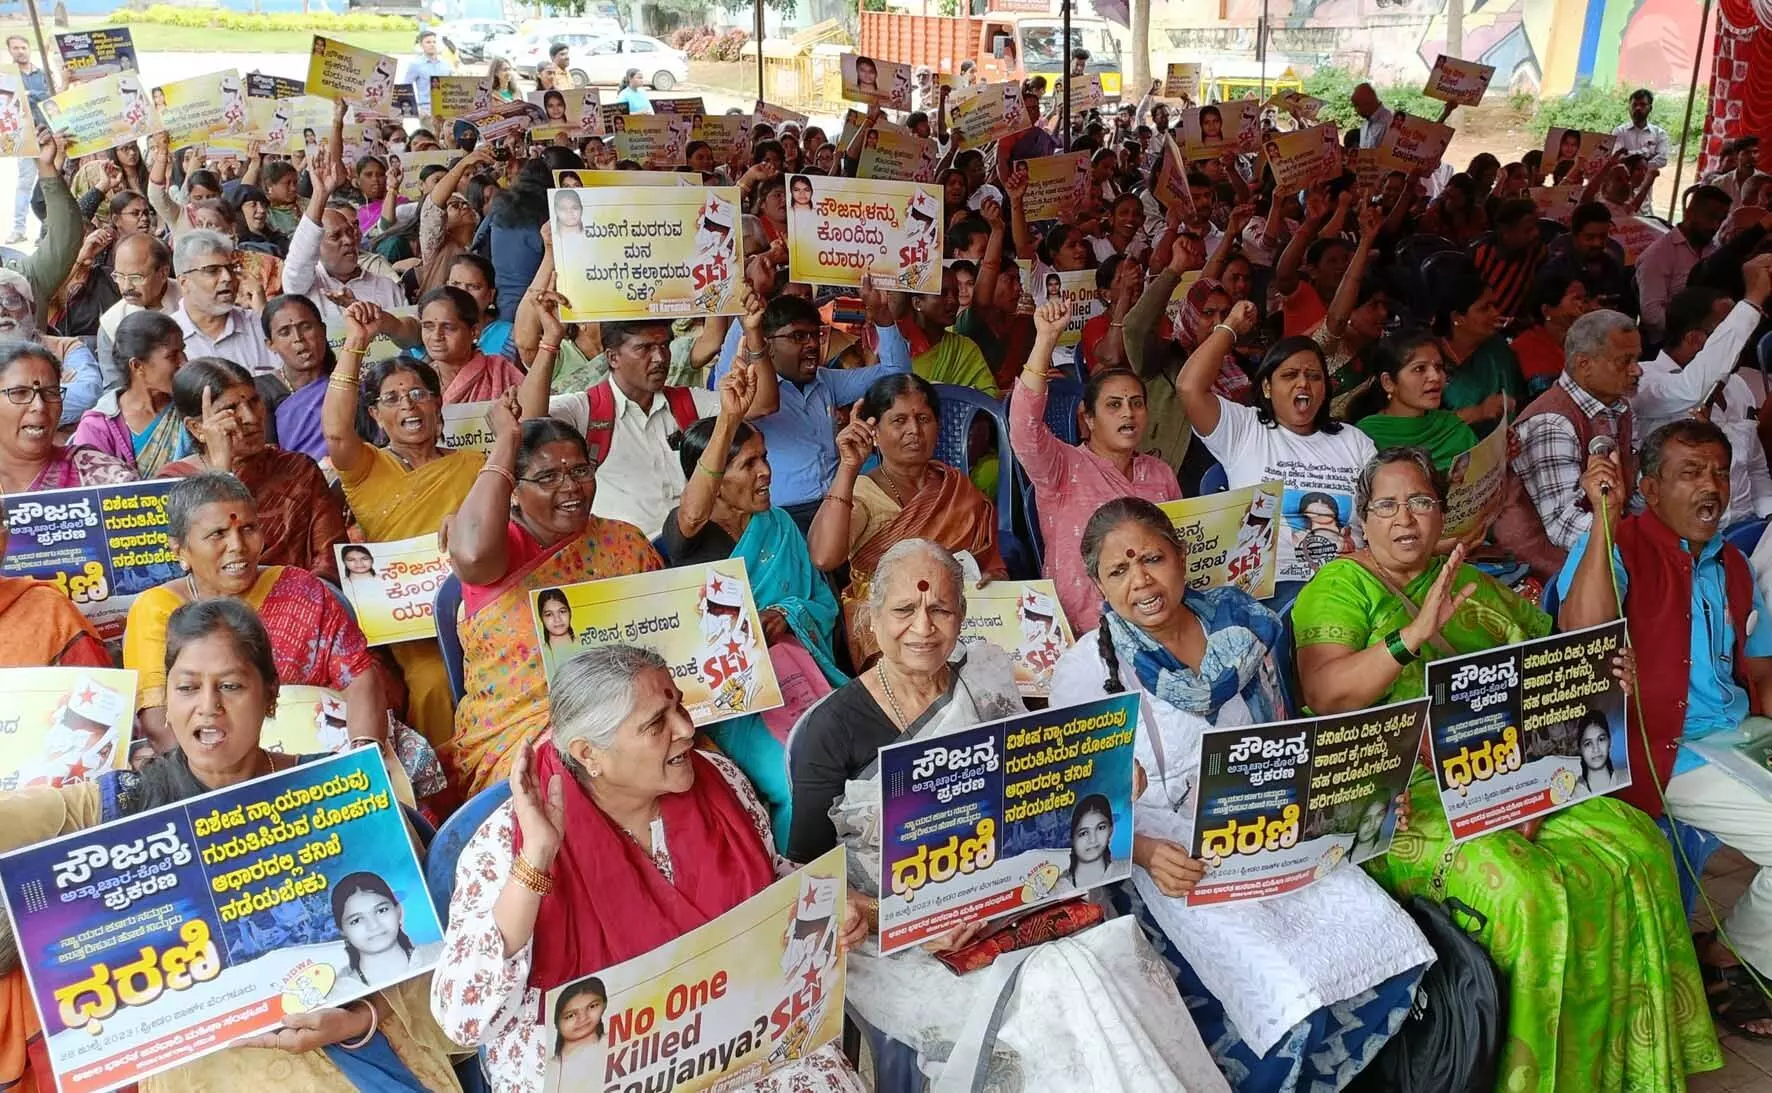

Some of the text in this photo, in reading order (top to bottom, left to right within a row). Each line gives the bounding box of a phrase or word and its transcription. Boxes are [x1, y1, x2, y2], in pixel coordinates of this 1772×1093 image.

[585, 219, 682, 239] ಮುನಿಗೆ ಮರಗುವ
[816, 197, 900, 230] ಸೌಜನ್ಯಳನ್ನು
[624, 242, 652, 260] ಮನ
[817, 223, 887, 254] ಕೊಂದಿದ್ದು
[632, 262, 691, 287] ಕಲ್ಲಾದುದು
[818, 249, 875, 270] ಯಾರು?
[626, 281, 656, 302] ಏಕೆ?
[1062, 289, 1076, 301] No
[1072, 302, 1091, 316] lled
[446, 429, 483, 448] ಮುನಿಗೆ
[8, 498, 98, 527] ಸೌಜನ್ಯ
[103, 495, 139, 511] ವಿಶೇಷ
[11, 519, 84, 536] ಅತ್ಯಾಚಾರ-ಕೊಲೆ
[37, 529, 87, 546] ಪ್ರಕರಣ
[1189, 550, 1228, 573] ತನಿಖೆ
[580, 612, 681, 645] ಸೌಜನ್ಯ ಪ್ರಕರಣದ
[1523, 636, 1617, 669] ತನಿಖೆಯ ದಿಕ್ಕು ತಪ್ಪಿಸಿದ
[1451, 655, 1519, 692] ಸೌಜನ್ಯ
[1523, 664, 1596, 690] ಕಾಣದ ಕೈಗಳನ್ನು
[1470, 692, 1508, 713] ಪ್ರಕರಣ
[1523, 678, 1610, 710] ಸಹ ಆರೋಪಿಗಳೆಂದು
[1006, 707, 1128, 750] ವಿಶೇಷ ನ್ಯಾಯಾಲಯವು
[1316, 712, 1417, 748] ತನಿಖೆಯ ದಿಕ್ಕು ತಪ್ಪಿಸಿದ
[912, 735, 1000, 780] ಸೌಜನ್ಯ
[1005, 728, 1134, 774] ಗುರುತಿಸಿರುವ ಲೋಪಗಳ
[1228, 731, 1310, 765] ಸೌಜನ್ಯ
[1314, 740, 1389, 769] ಕಾಣದ ಕೈಗಳನ್ನು
[1442, 725, 1521, 797] ಧರಣಿ
[912, 765, 985, 793] ಅತ್ಯಾಚಾರ-ಕೊಲೆ
[1005, 759, 1094, 799] ಆಧಾರದಲ್ಲಿ ತನಿಖೆ
[1227, 756, 1296, 775] ಅತ್ಯಾಚಾರ-ಕೊಲೆ
[1249, 767, 1295, 787] ಪ್ರಕರಣ
[1311, 755, 1401, 790] ಸಹ ಆರೋಪಿಗಳೆಂದು
[194, 768, 371, 838] ವಿಶೇಷ ನ್ಯಾಯಾಲಯವು
[936, 777, 985, 804] ಪ್ರಕರಣ
[1004, 790, 1076, 825] ನಡೆಯಬೇಕು
[201, 791, 391, 866] ಗುರುತಿಸಿರುವ ಲೋಪಗಳ
[1201, 803, 1301, 869] ಧರಣಿ
[51, 821, 193, 890] ಸೌಜನ್ಯ
[211, 832, 343, 894] ಆಧಾರದಲ್ಲಿ ತನಿಖೆ
[890, 816, 998, 902] ಧರಣಿ
[60, 859, 174, 905] ಅತ್ಯಾಚಾರ-ಕೊಲೆ
[104, 873, 179, 912] ಪ್ರಕರಣ
[218, 872, 328, 923] ನಡೆಯಬೇಕು
[52, 918, 223, 1036] ಧರಣಿ
[281, 958, 314, 985] AIDWA
[608, 970, 729, 1049] No One
[103, 1029, 133, 1048] 2023
[604, 1012, 702, 1084] Killed
